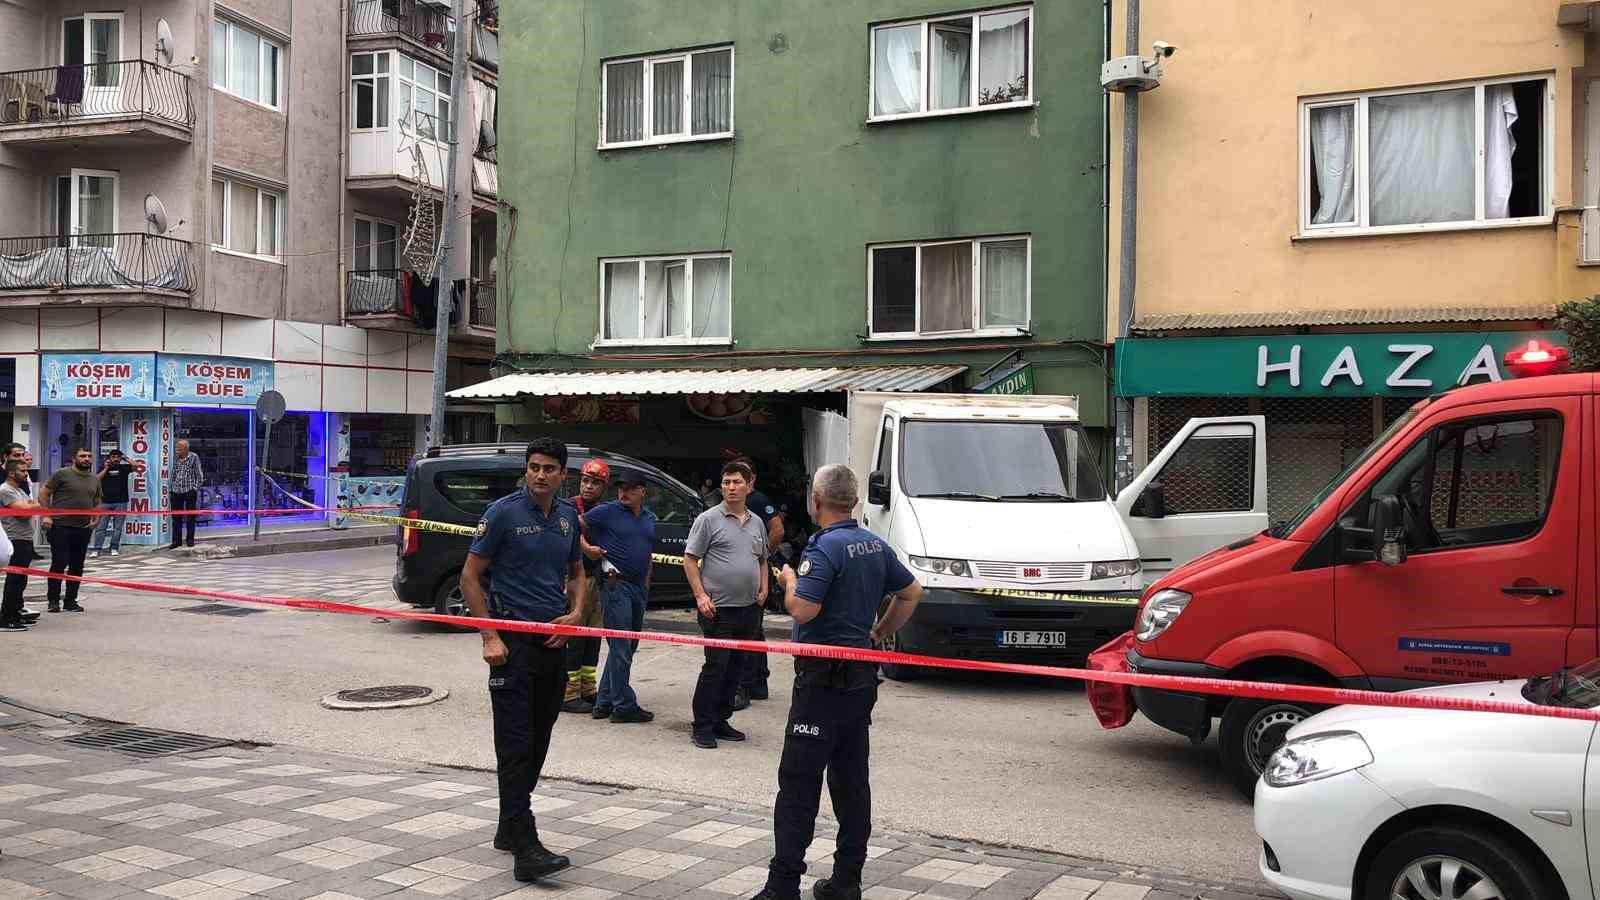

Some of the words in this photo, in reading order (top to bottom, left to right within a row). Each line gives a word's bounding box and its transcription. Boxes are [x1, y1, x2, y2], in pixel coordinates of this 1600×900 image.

[67, 361, 131, 380] KÖŞEM
[186, 362, 251, 381] KÖŞEM
[76, 382, 123, 397] BÜFE
[196, 382, 244, 397] BÜFE
[126, 519, 152, 535] BÜFE
[1023, 568, 1041, 577] BMC
[1006, 632, 1018, 643] 16
[1024, 632, 1031, 643] F
[1037, 632, 1064, 644] 7910
